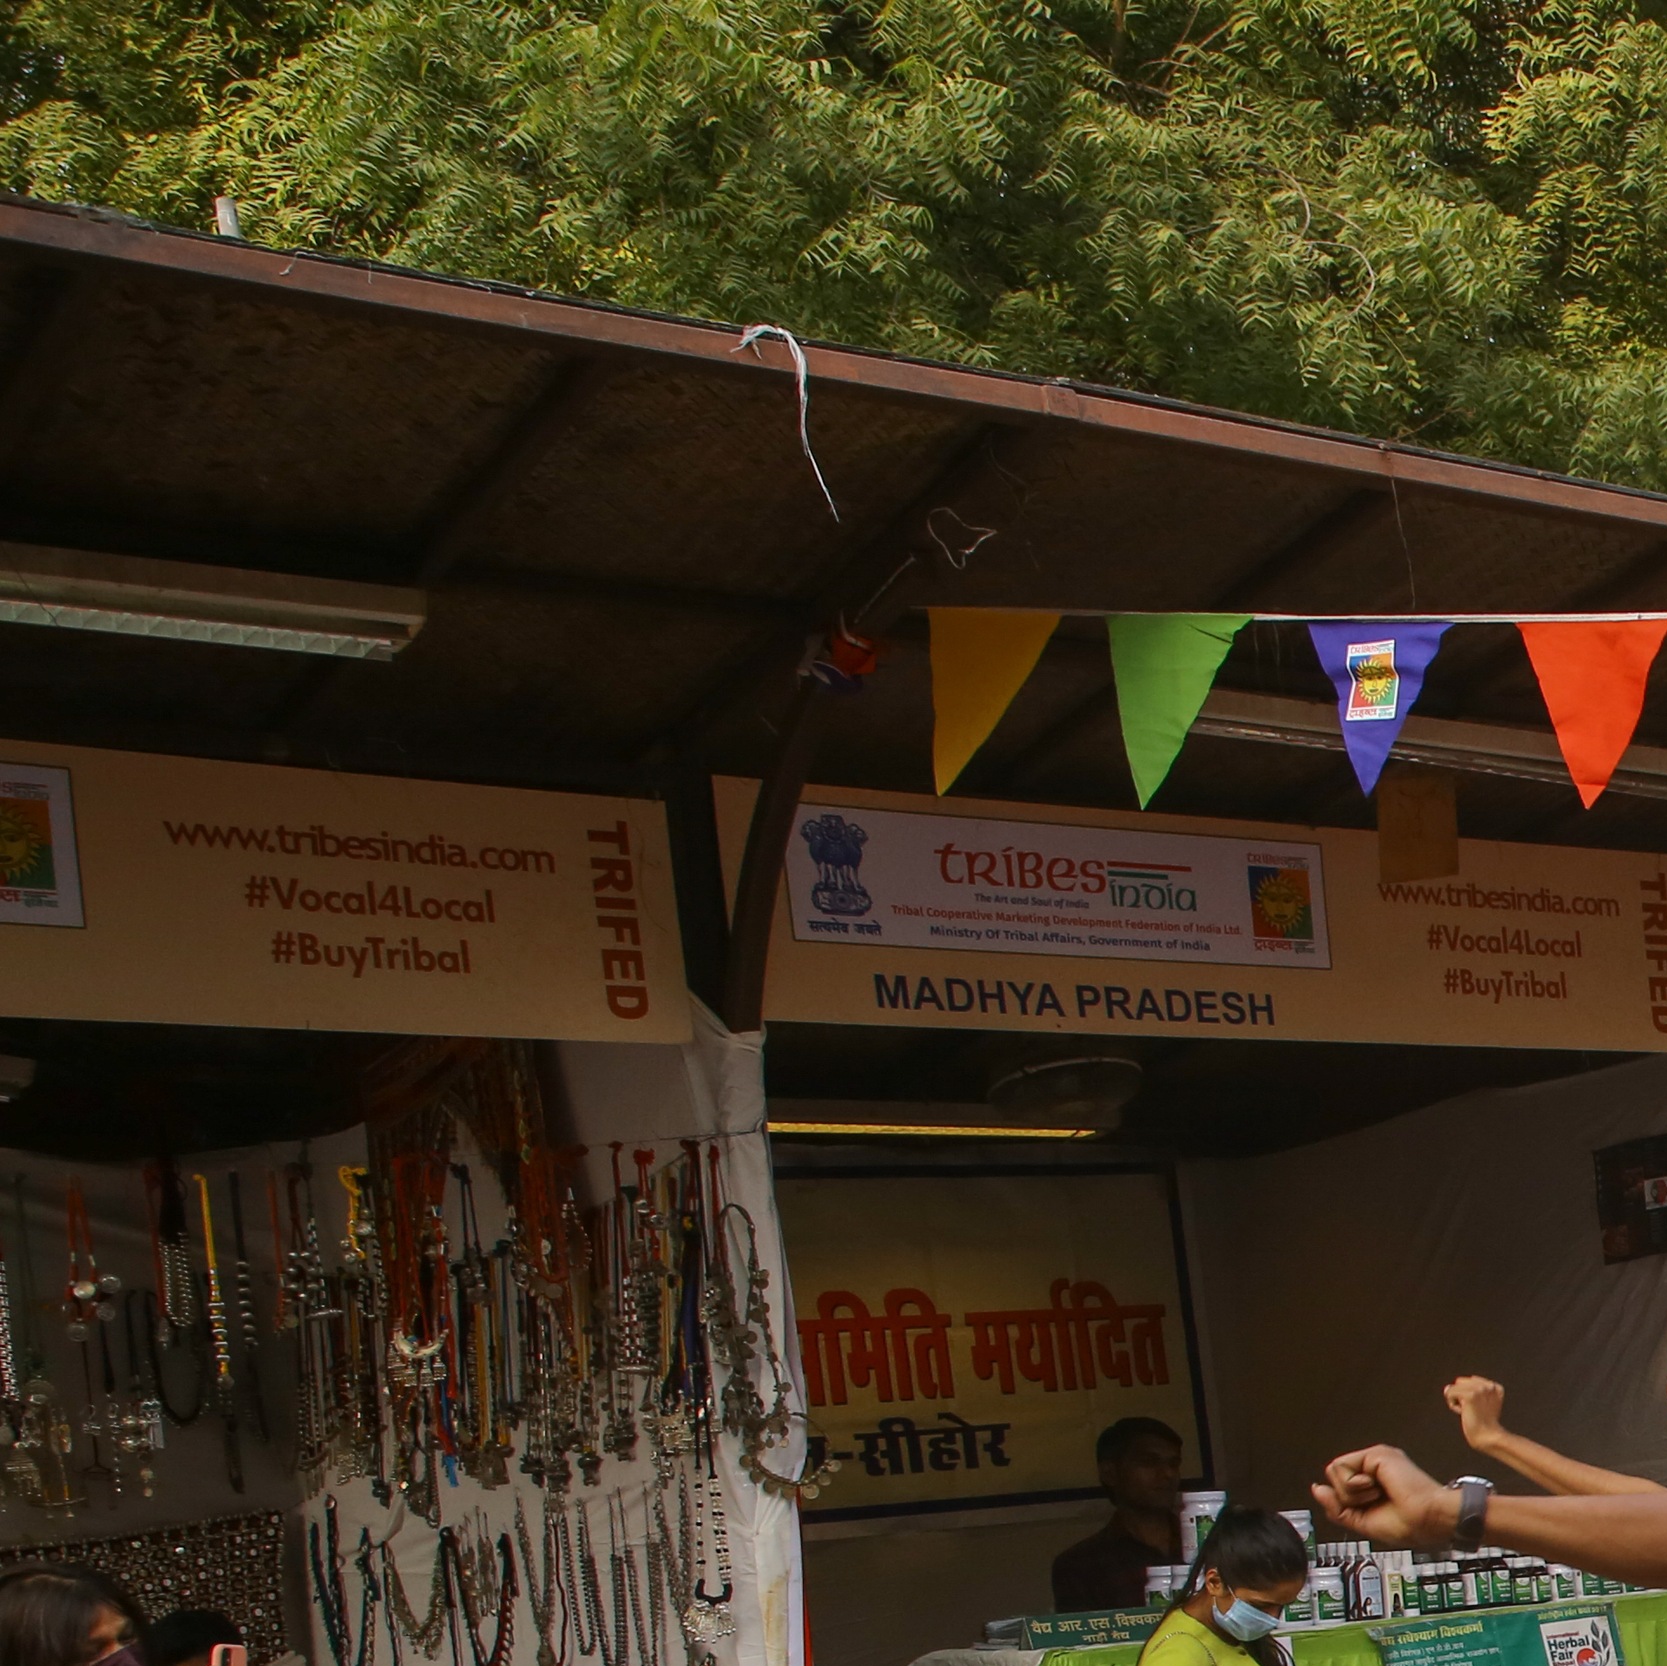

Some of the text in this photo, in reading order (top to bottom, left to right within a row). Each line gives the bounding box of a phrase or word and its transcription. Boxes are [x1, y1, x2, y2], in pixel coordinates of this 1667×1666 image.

[163, 819, 556, 874] www.tribesindia.com
[245, 876, 496, 922] #Vocal4Local
[1378, 883, 1620, 917] www.tribesindia.com
[587, 820, 648, 1020] TRIFED
[891, 904, 925, 917] Tribal
[926, 907, 993, 921] Cooperative
[996, 911, 1050, 928] Marketing
[1053, 915, 1123, 930] Development
[1125, 919, 1182, 932] Federation
[1184, 922, 1194, 933] of
[1196, 923, 1222, 934] India
[272, 932, 472, 979] #BuyTribal
[930, 926, 1211, 951] Ministry Of Tribal Affairs, Government of India
[1427, 923, 1583, 957] #Vocal4Local
[874, 974, 1276, 1026] MADHYA PRADESH
[1444, 967, 1568, 1004] #BuyTribal
[965, 1278, 1170, 1395] मर्यादित
[1547, 1635, 1590, 1651] Herbal
[1550, 1650, 1573, 1662] Fair
